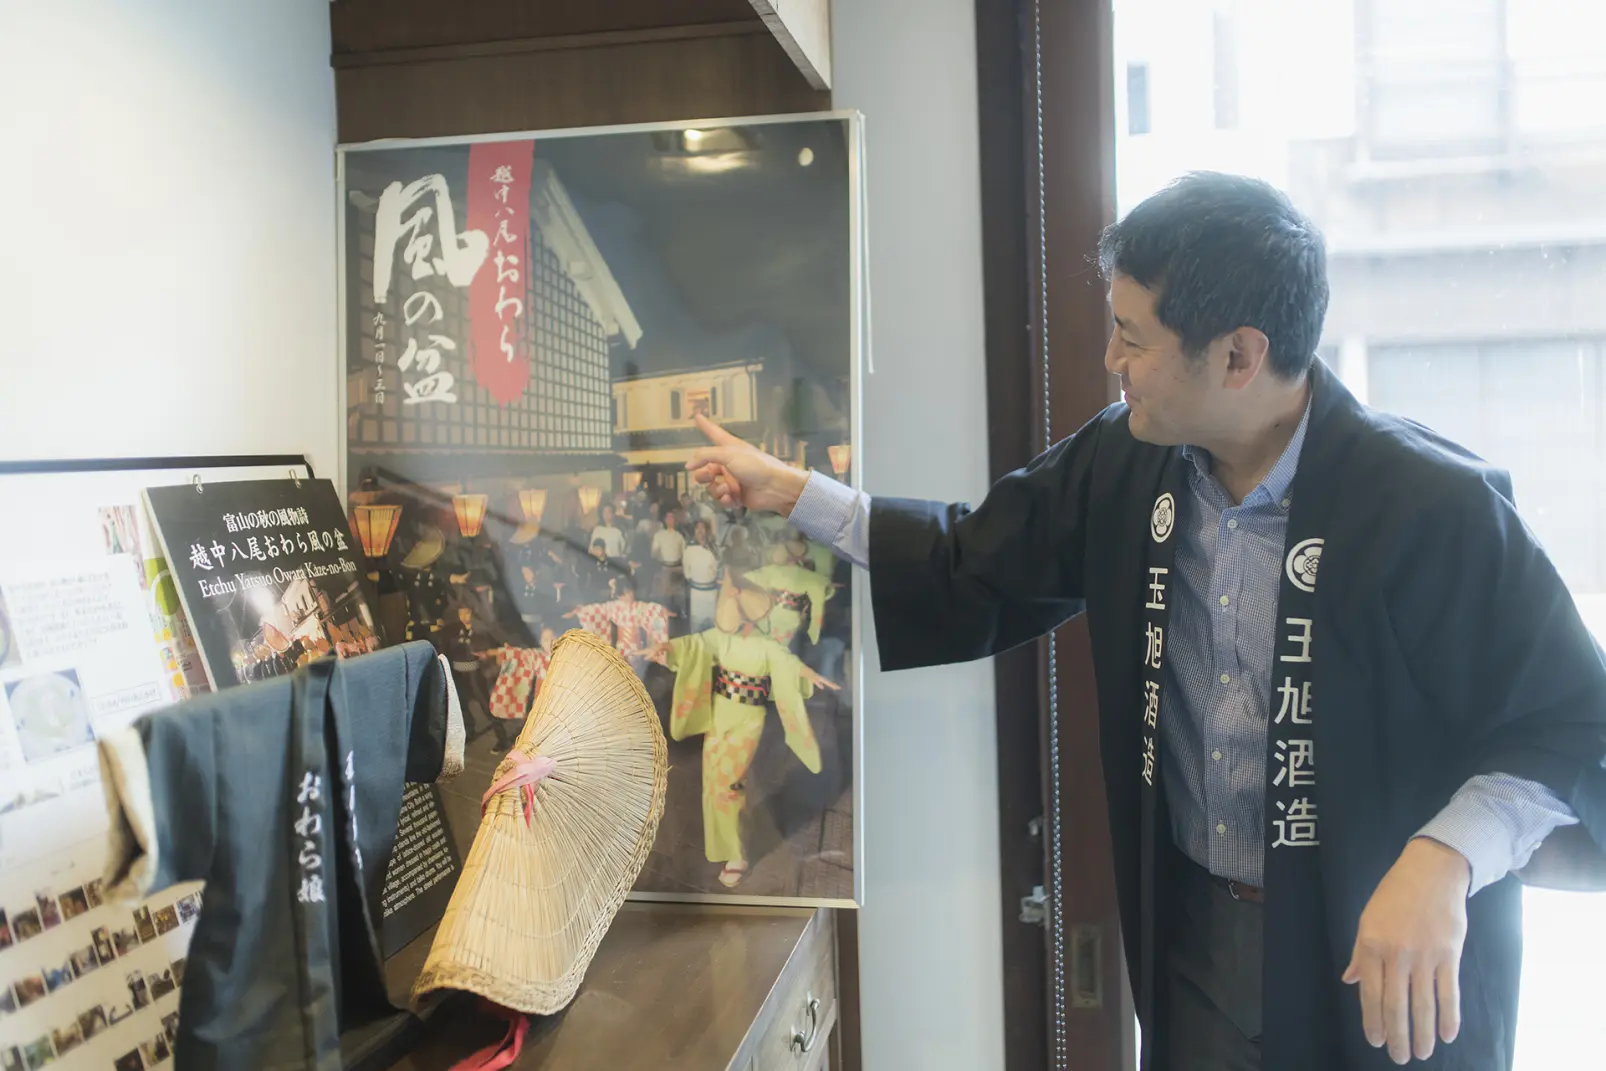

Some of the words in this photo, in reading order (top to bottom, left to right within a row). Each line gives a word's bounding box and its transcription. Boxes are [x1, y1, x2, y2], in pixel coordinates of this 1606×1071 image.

[373, 173, 489, 405] 風の盆
[490, 165, 523, 363] 越中八尾おわら
[188, 528, 349, 571] 越中八尾おわら風の盆
[198, 578, 236, 599] Etchu
[235, 570, 273, 592] Yatsuo
[273, 564, 306, 584] Owara
[304, 558, 357, 578] Kaze-no-Bon
[222, 506, 310, 533] 富山の秋の風物詩
[1141, 566, 1168, 787] 玉旭酒造
